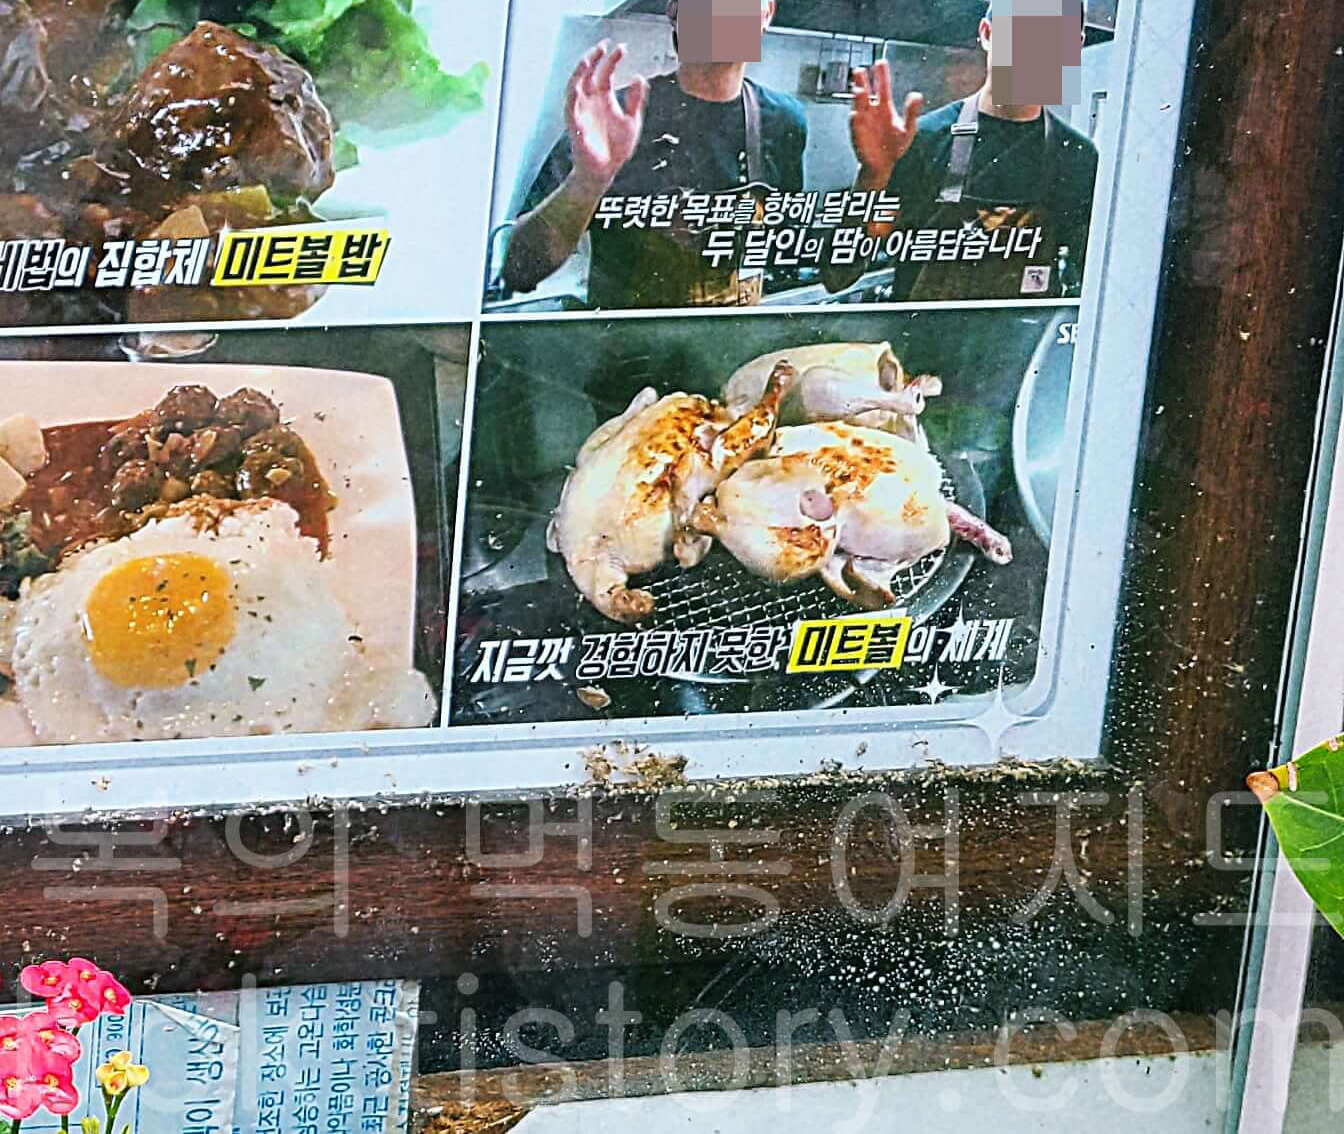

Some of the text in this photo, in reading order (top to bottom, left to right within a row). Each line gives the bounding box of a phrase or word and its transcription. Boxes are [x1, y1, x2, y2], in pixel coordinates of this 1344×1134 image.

[595, 188, 901, 229] 뚜렷한 목표를 향해 달리는
[94, 238, 208, 287] 집합체
[220, 235, 331, 281] 미트볼
[338, 232, 384, 278] 밥
[701, 222, 1043, 267] 두 달인의 땀이 아름답습니다
[469, 638, 575, 684] 지금껏
[575, 633, 712, 680] 경험하지
[713, 628, 785, 676] 못한
